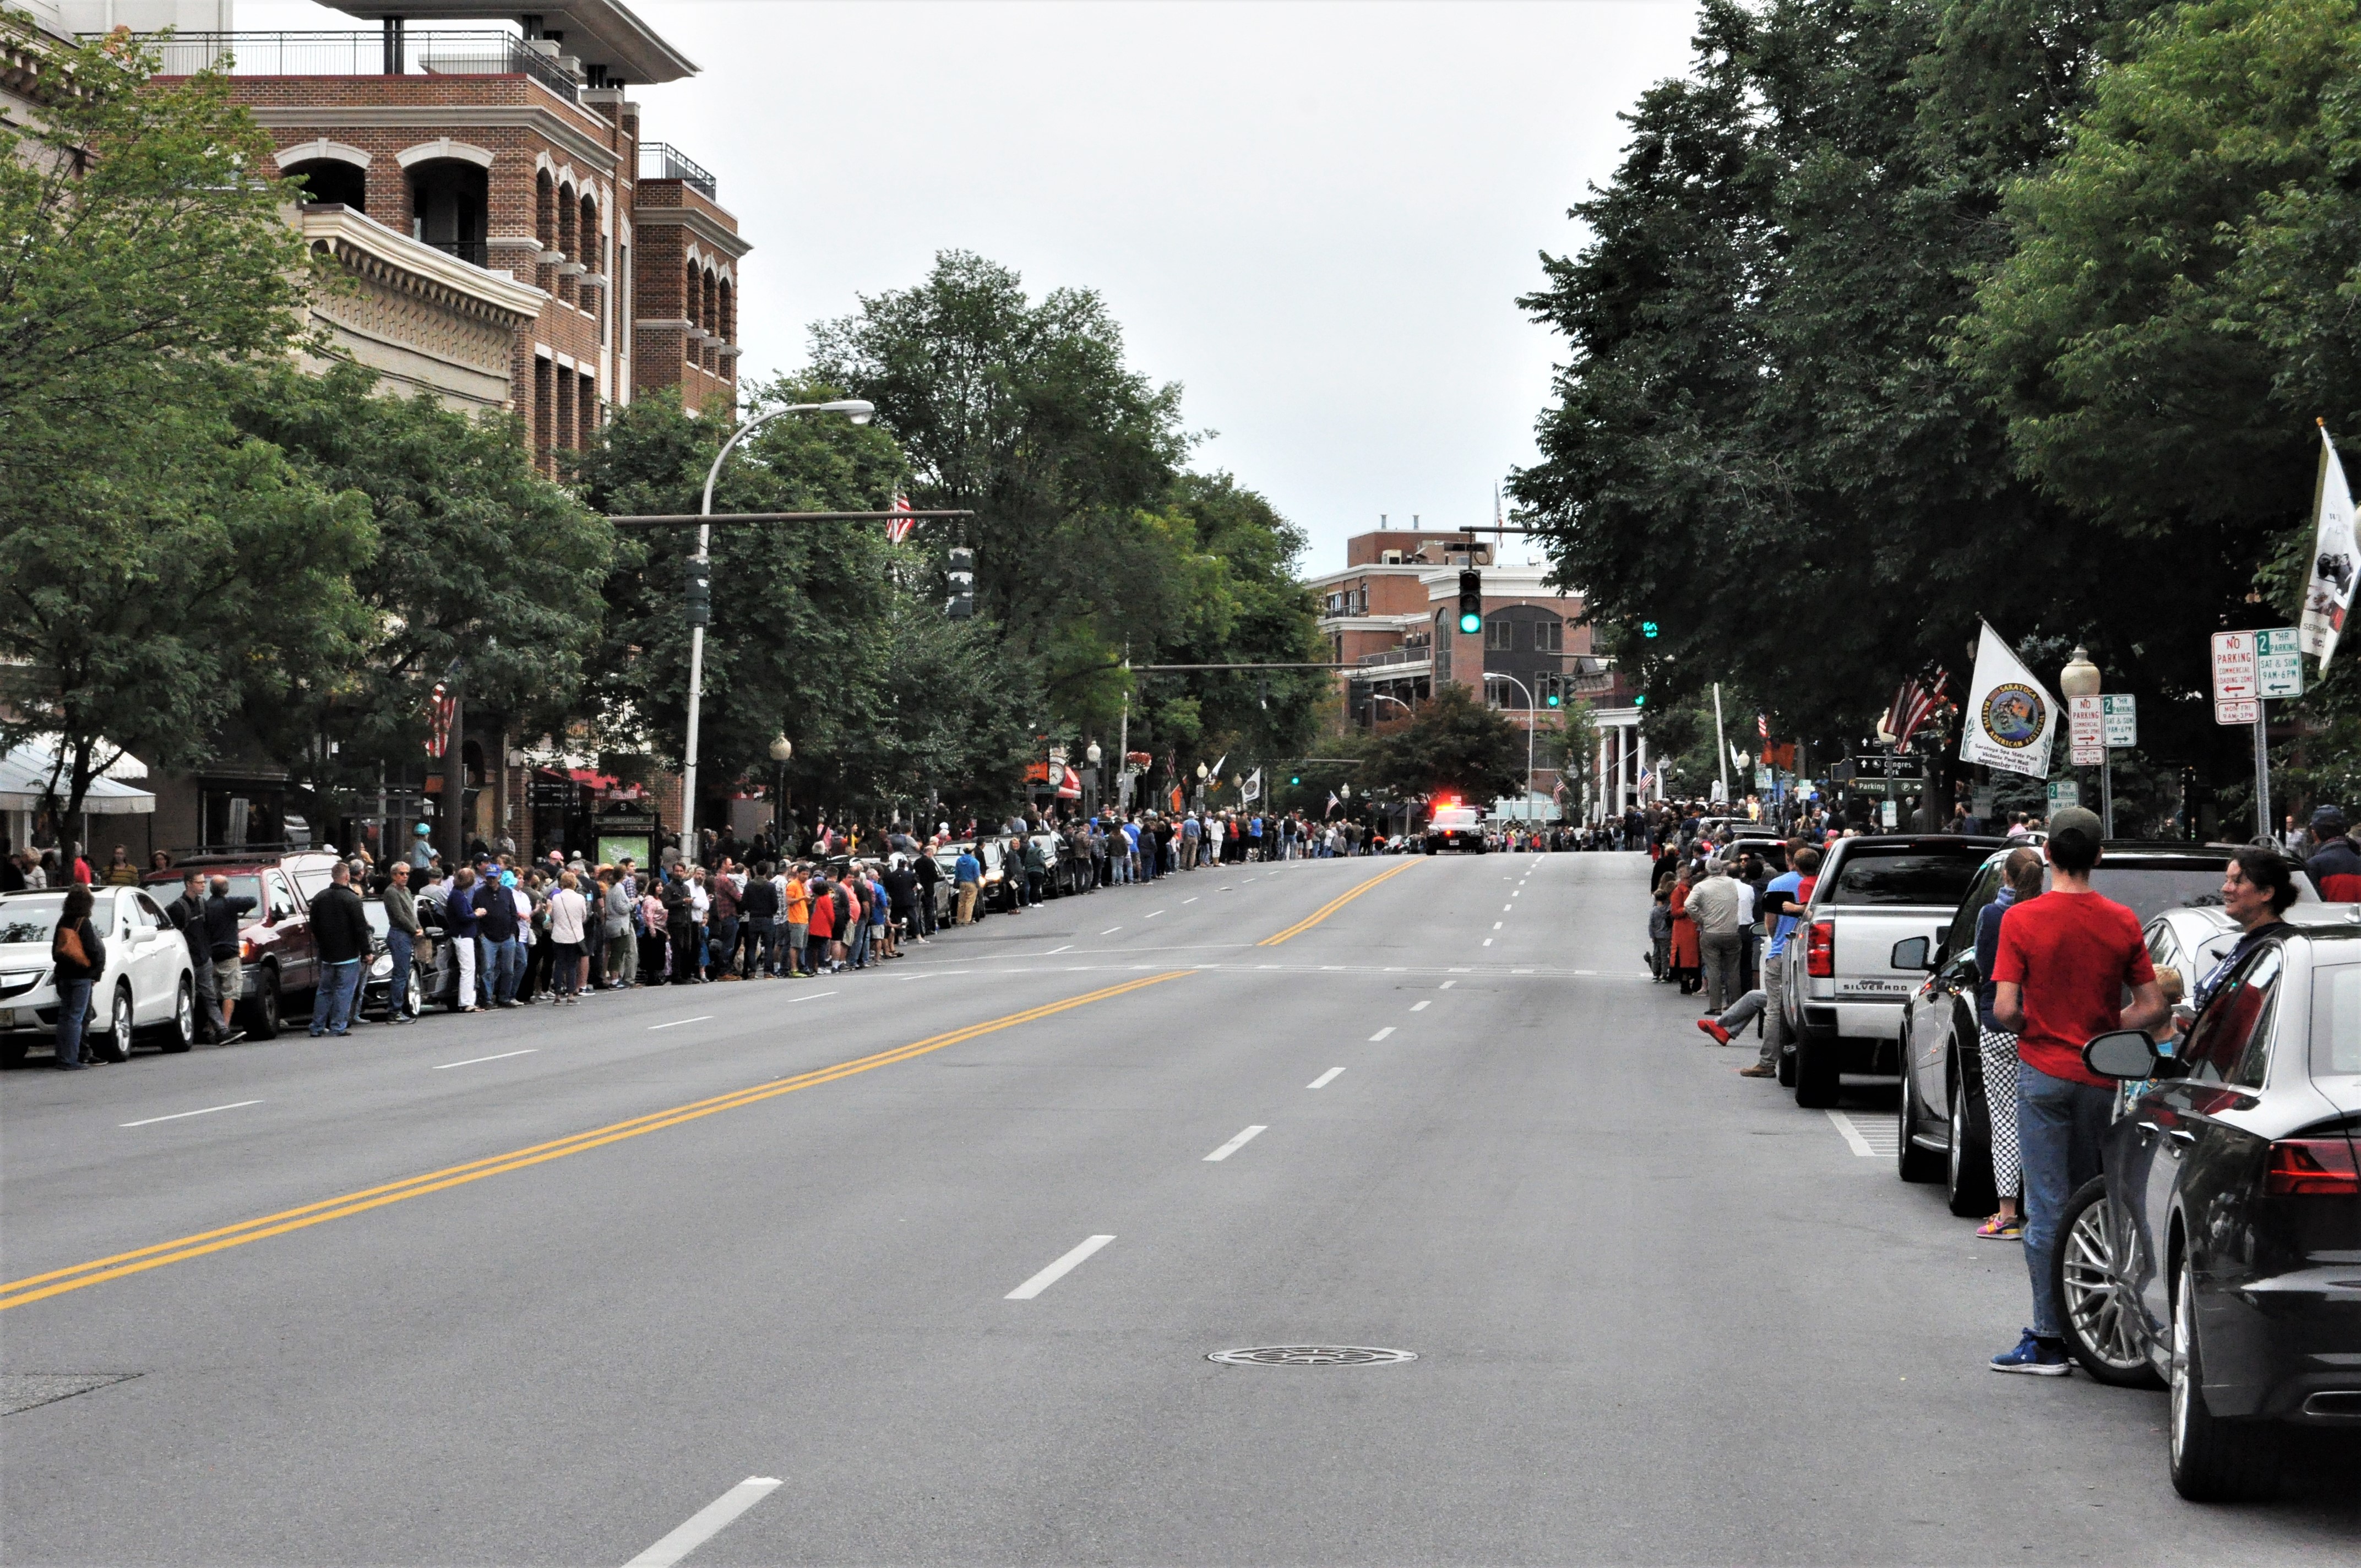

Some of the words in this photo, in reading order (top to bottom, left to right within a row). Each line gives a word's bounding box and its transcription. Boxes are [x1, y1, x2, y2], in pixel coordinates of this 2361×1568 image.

[2227, 639, 2240, 649] NO
[2259, 635, 2267, 652] 2
[2270, 643, 2298, 652] PARKING
[2217, 653, 2251, 663] PARKING
[2261, 660, 2272, 668] SAT
[2284, 658, 2298, 667] SUN
[2000, 684, 2036, 699] SARATOGA
[2080, 700, 2091, 709] NO
[2105, 699, 2110, 711] 2
[1982, 701, 1991, 728] NATIVE
[1989, 731, 2023, 748] AMERICAN
[2026, 716, 2044, 744] FESTIVAL
[1974, 743, 1998, 753] Saratoga
[1982, 752, 2003, 760] Victoria
[1884, 761, 1914, 769] Cngres
[1977, 756, 2011, 769] September
[1859, 783, 1885, 791] Parking
[2050, 786, 2055, 797] 2
[620, 803, 627, 811] S
